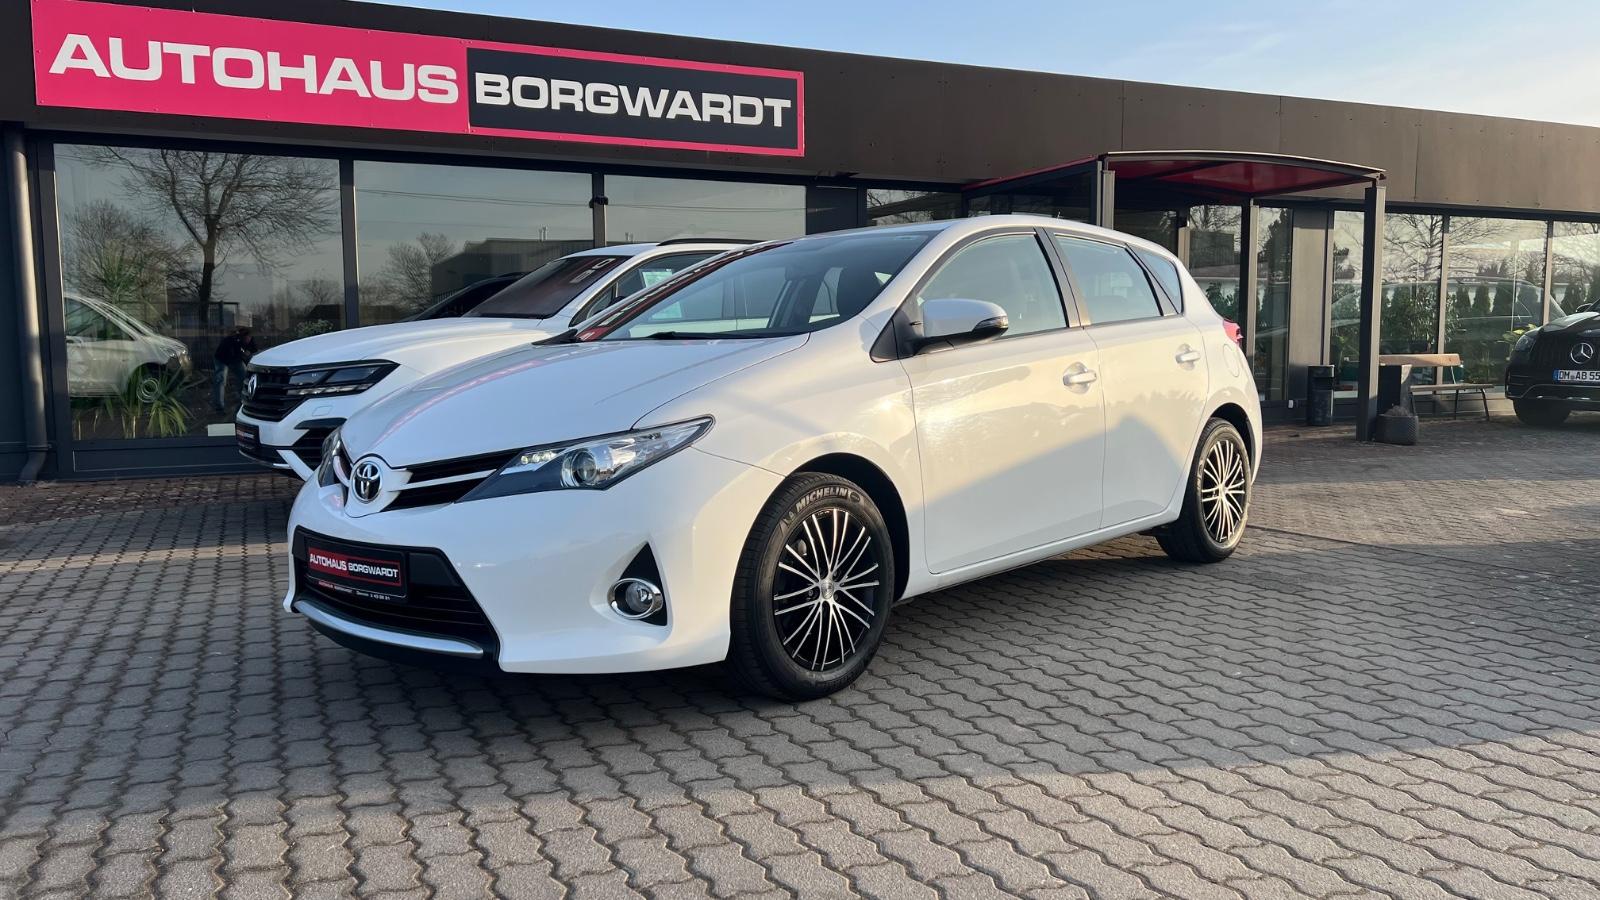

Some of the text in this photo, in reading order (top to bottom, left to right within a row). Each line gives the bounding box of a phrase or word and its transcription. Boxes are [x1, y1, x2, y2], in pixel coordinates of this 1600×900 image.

[49, 34, 791, 127] AUTOHAUS BORGWARDT
[1576, 371, 1587, 380] AB
[796, 487, 848, 512] MICHELIN
[309, 553, 398, 577] AUTOHAUS BORGWARDT
